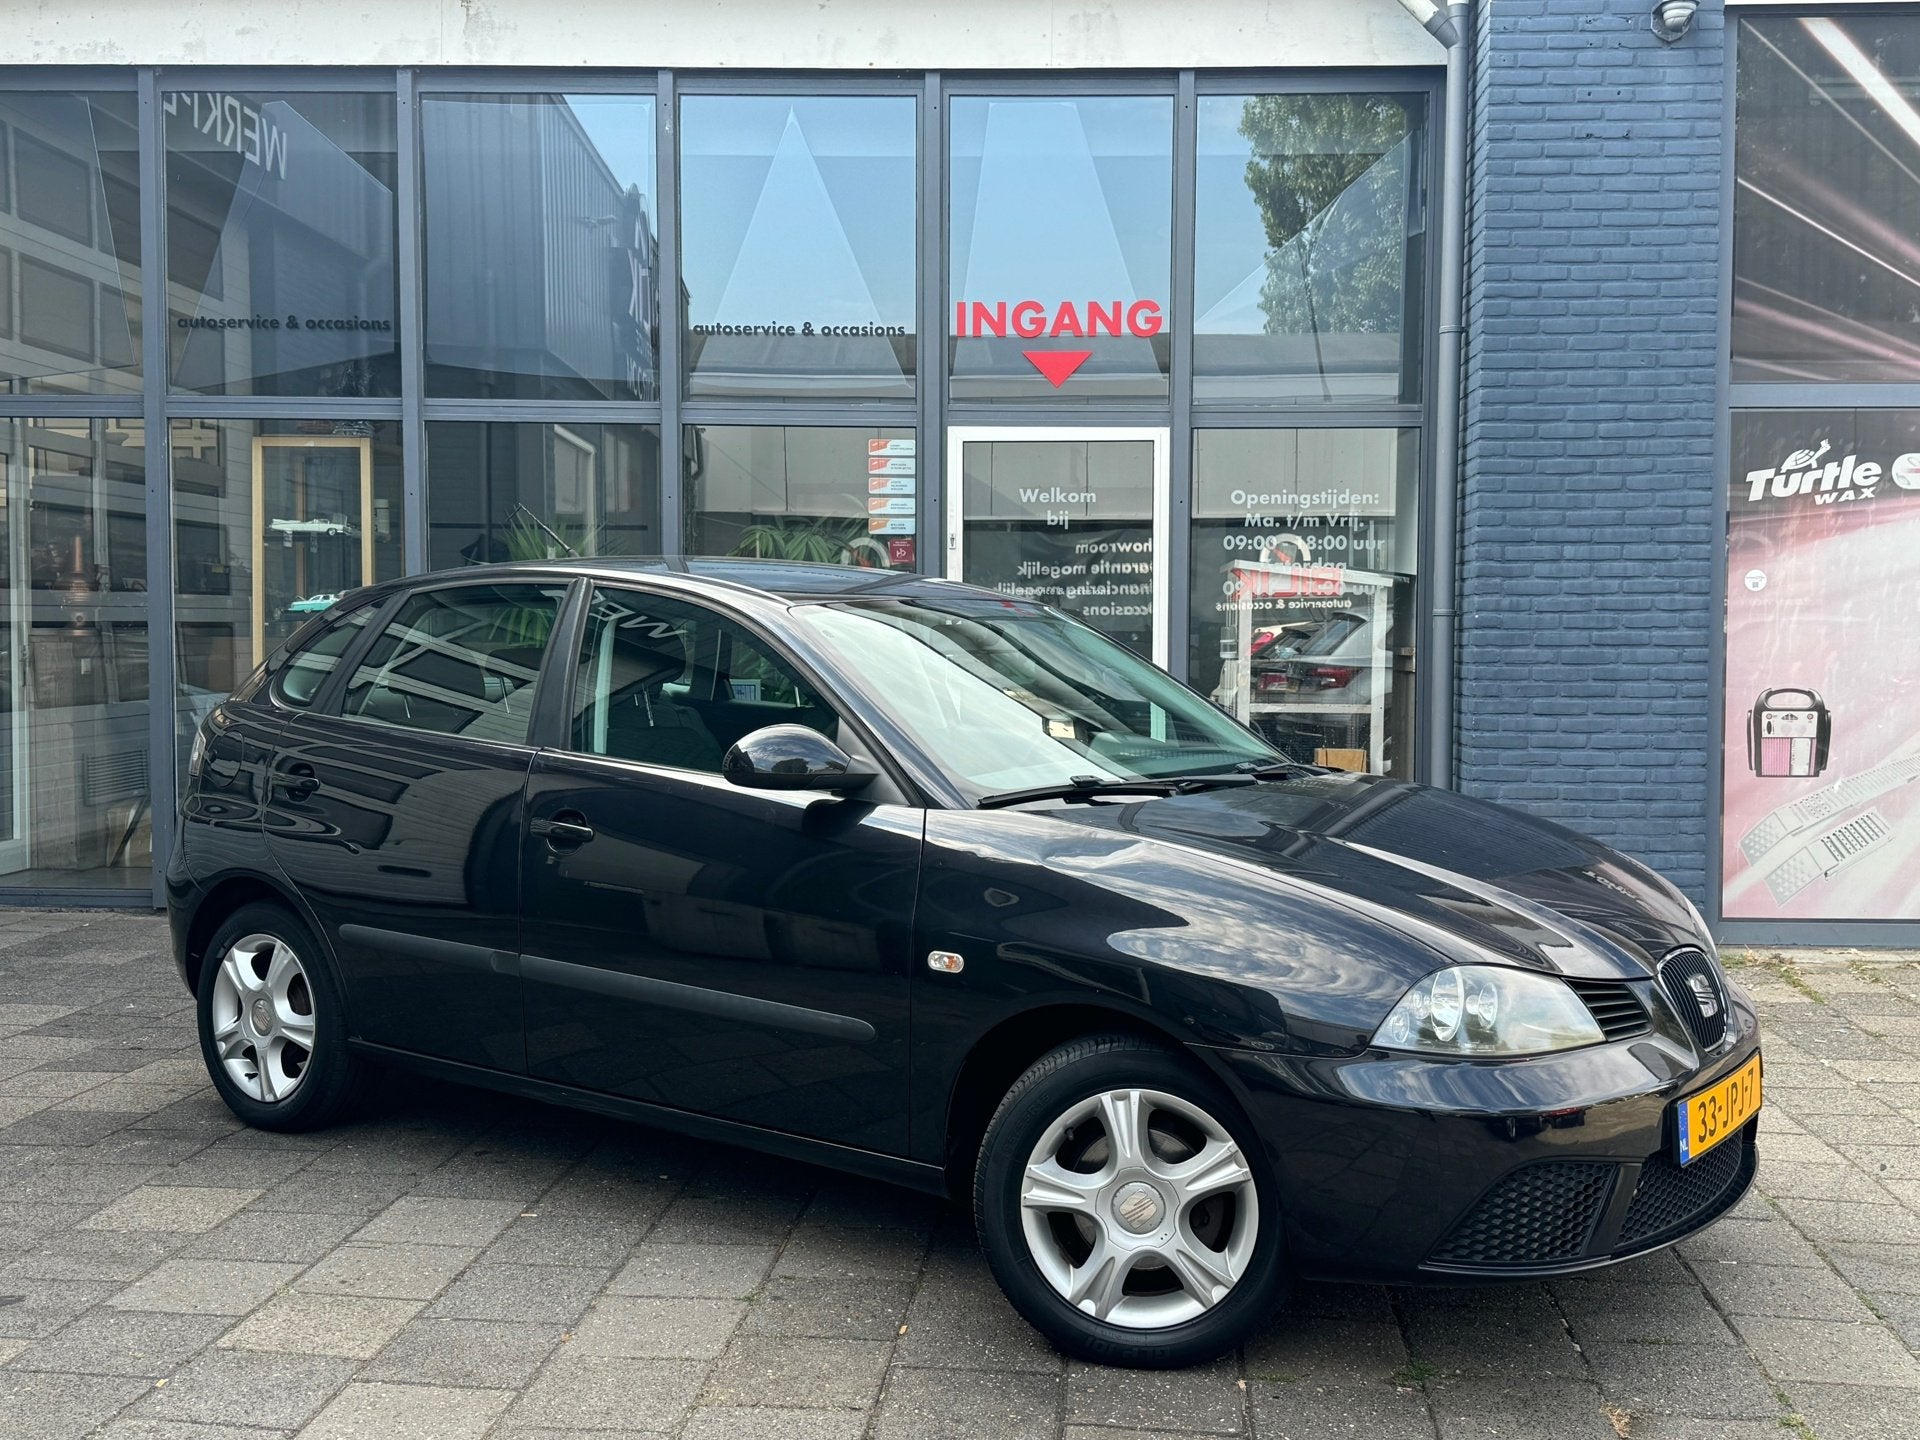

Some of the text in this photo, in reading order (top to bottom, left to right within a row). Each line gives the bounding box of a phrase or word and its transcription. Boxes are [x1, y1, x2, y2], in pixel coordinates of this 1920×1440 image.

[177, 314, 391, 332] autoservice & occasions
[693, 320, 906, 338] autoservice & occasions
[956, 299, 1163, 339] INGANG
[1745, 454, 1883, 502] Turtle
[1018, 487, 1097, 503] Welkom
[1230, 488, 1379, 509] Openingstijden:
[1814, 486, 1877, 506] WAX
[1046, 510, 1070, 530] bij
[1244, 511, 1365, 532] Ma. t/m Vrij.
[1223, 534, 1278, 551] 09:00
[1353, 538, 1386, 551] uur
[1698, 1066, 1754, 1144] 33-JPJ-7
